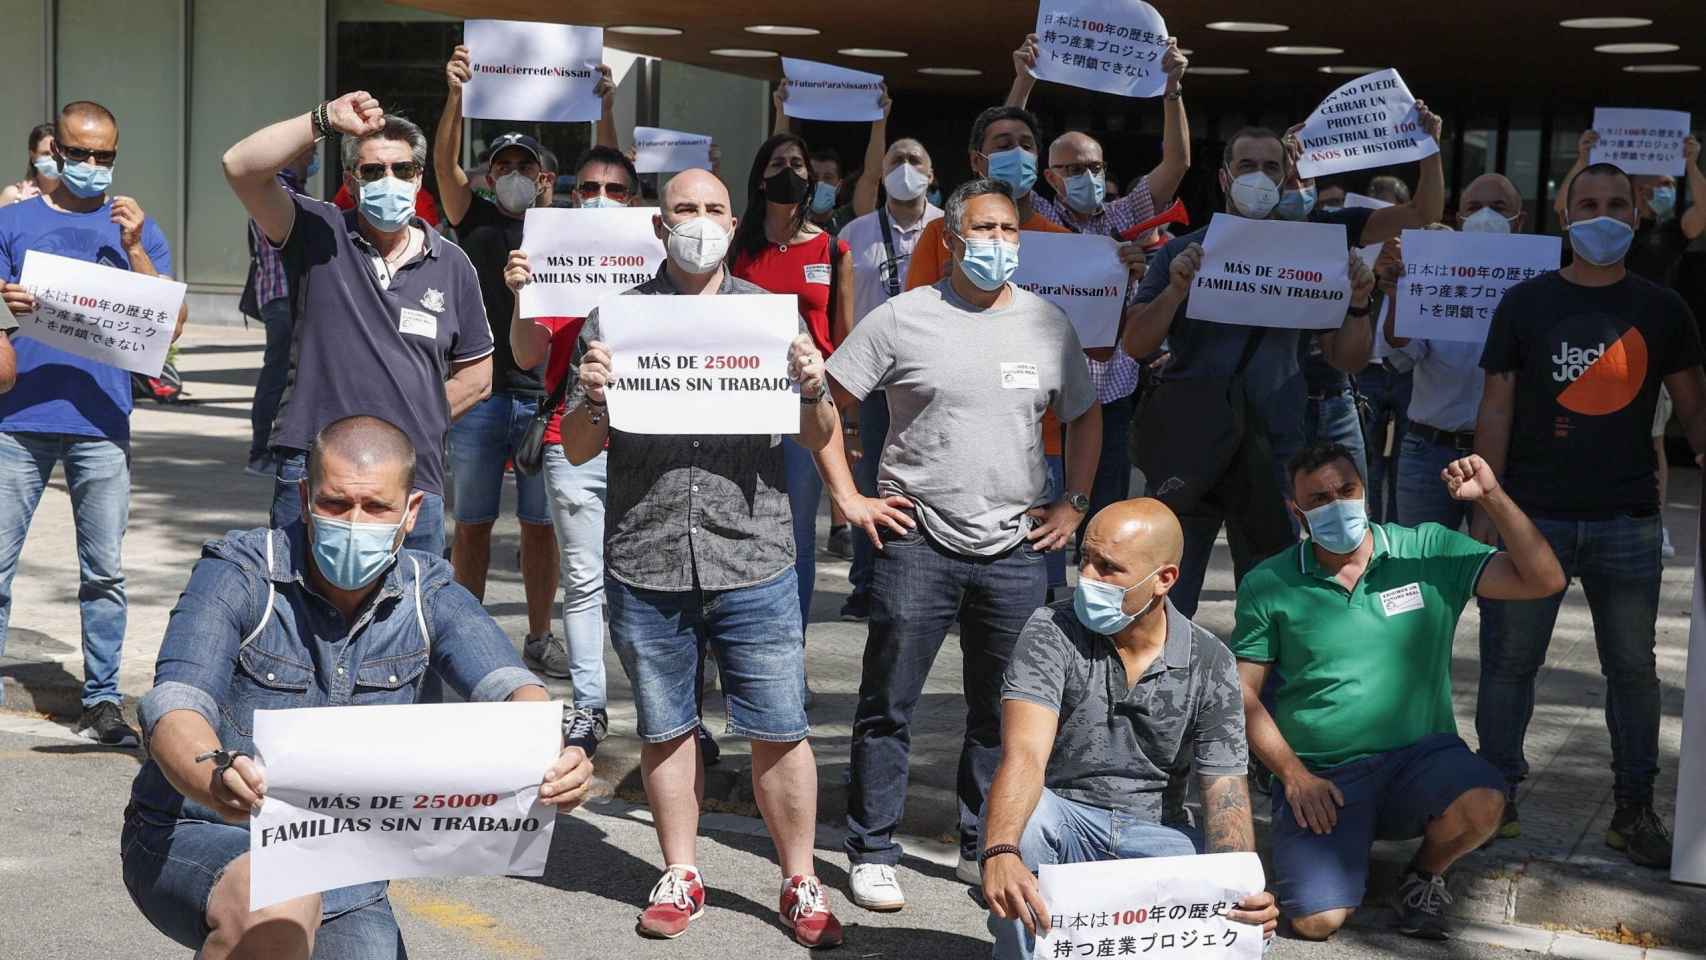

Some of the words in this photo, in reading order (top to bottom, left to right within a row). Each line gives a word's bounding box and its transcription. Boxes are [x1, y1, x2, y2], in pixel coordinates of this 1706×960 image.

[1044, 30, 1158, 62] 持つ産業プロジェク
[473, 63, 591, 78] #noalcierredeNissan
[1050, 50, 1150, 78] トを閉鎖できない
[1340, 87, 1357, 97] NO
[1360, 78, 1399, 92] PUEDE
[1320, 99, 1367, 115] CERRAR
[1370, 96, 1386, 106] UN
[1326, 111, 1386, 129] PROYECTO
[1303, 131, 1369, 149] INDUSTRIAL
[1374, 127, 1388, 138] DE
[1393, 122, 1416, 134] 100
[1344, 147, 1360, 157] DE
[1363, 137, 1417, 155] HISTORIA
[547, 254, 574, 267] MÁS
[578, 256, 596, 267] DE
[600, 256, 645, 267] 25000
[528, 273, 581, 284] AMILIAS
[585, 273, 607, 284] SIN
[1224, 261, 1251, 275] MÁS
[1255, 266, 1273, 278] DE
[1278, 267, 1323, 283] 25000
[1198, 277, 1256, 294] FAMILIAS
[1260, 284, 1283, 297] SIN
[1287, 286, 1344, 301] TRABAJO
[1410, 283, 1507, 299] 持つ産業プロ
[1419, 303, 1497, 320] トを閉鎖で
[637, 353, 671, 369] MÁS
[677, 355, 698, 369] DE
[704, 355, 760, 369] 25000
[1552, 364, 1589, 382] Jo
[686, 377, 713, 391] SIN
[718, 377, 790, 392] TRABAJO
[308, 793, 360, 809] MÁS
[370, 796, 404, 809] DE
[413, 793, 498, 809] 25000
[261, 817, 371, 847] FAMILIAS
[380, 817, 421, 831] SIN
[432, 816, 539, 832] TRABAJO
[1053, 927, 1239, 959] 持つ産業プロジェク
